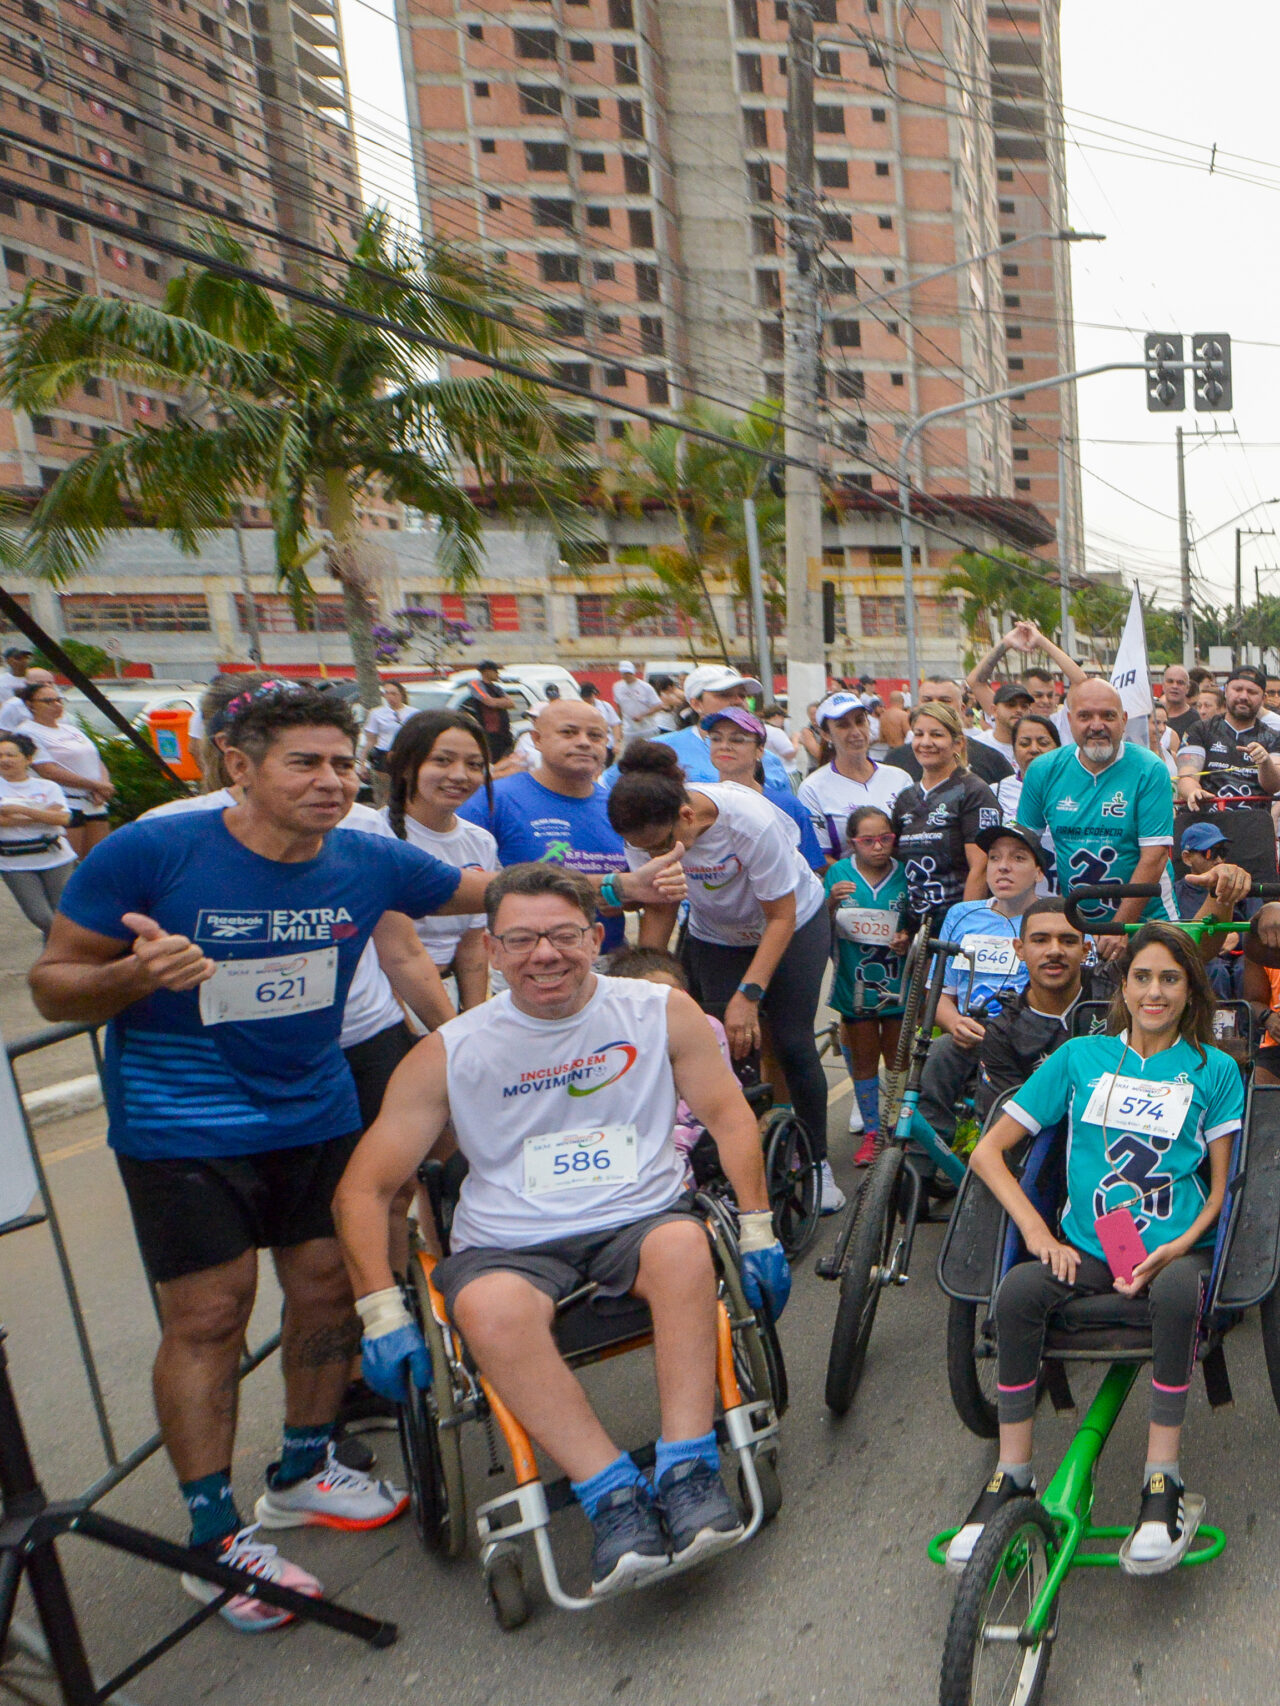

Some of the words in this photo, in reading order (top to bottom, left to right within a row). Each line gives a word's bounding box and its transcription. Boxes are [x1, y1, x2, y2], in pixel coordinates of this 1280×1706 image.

[1112, 669, 1137, 689] CIA
[582, 851, 627, 862] bem-esta
[564, 861, 603, 871] Inclusão
[206, 914, 264, 926] Reebok
[272, 907, 353, 926] EXTRA
[272, 923, 331, 942] MILE
[737, 931, 762, 941] 30
[851, 921, 891, 937] 3028
[976, 949, 1009, 965] 646
[255, 976, 306, 1003] 621
[586, 1053, 607, 1066] EM
[1118, 1096, 1164, 1121] 574
[553, 1149, 611, 1175] 586
